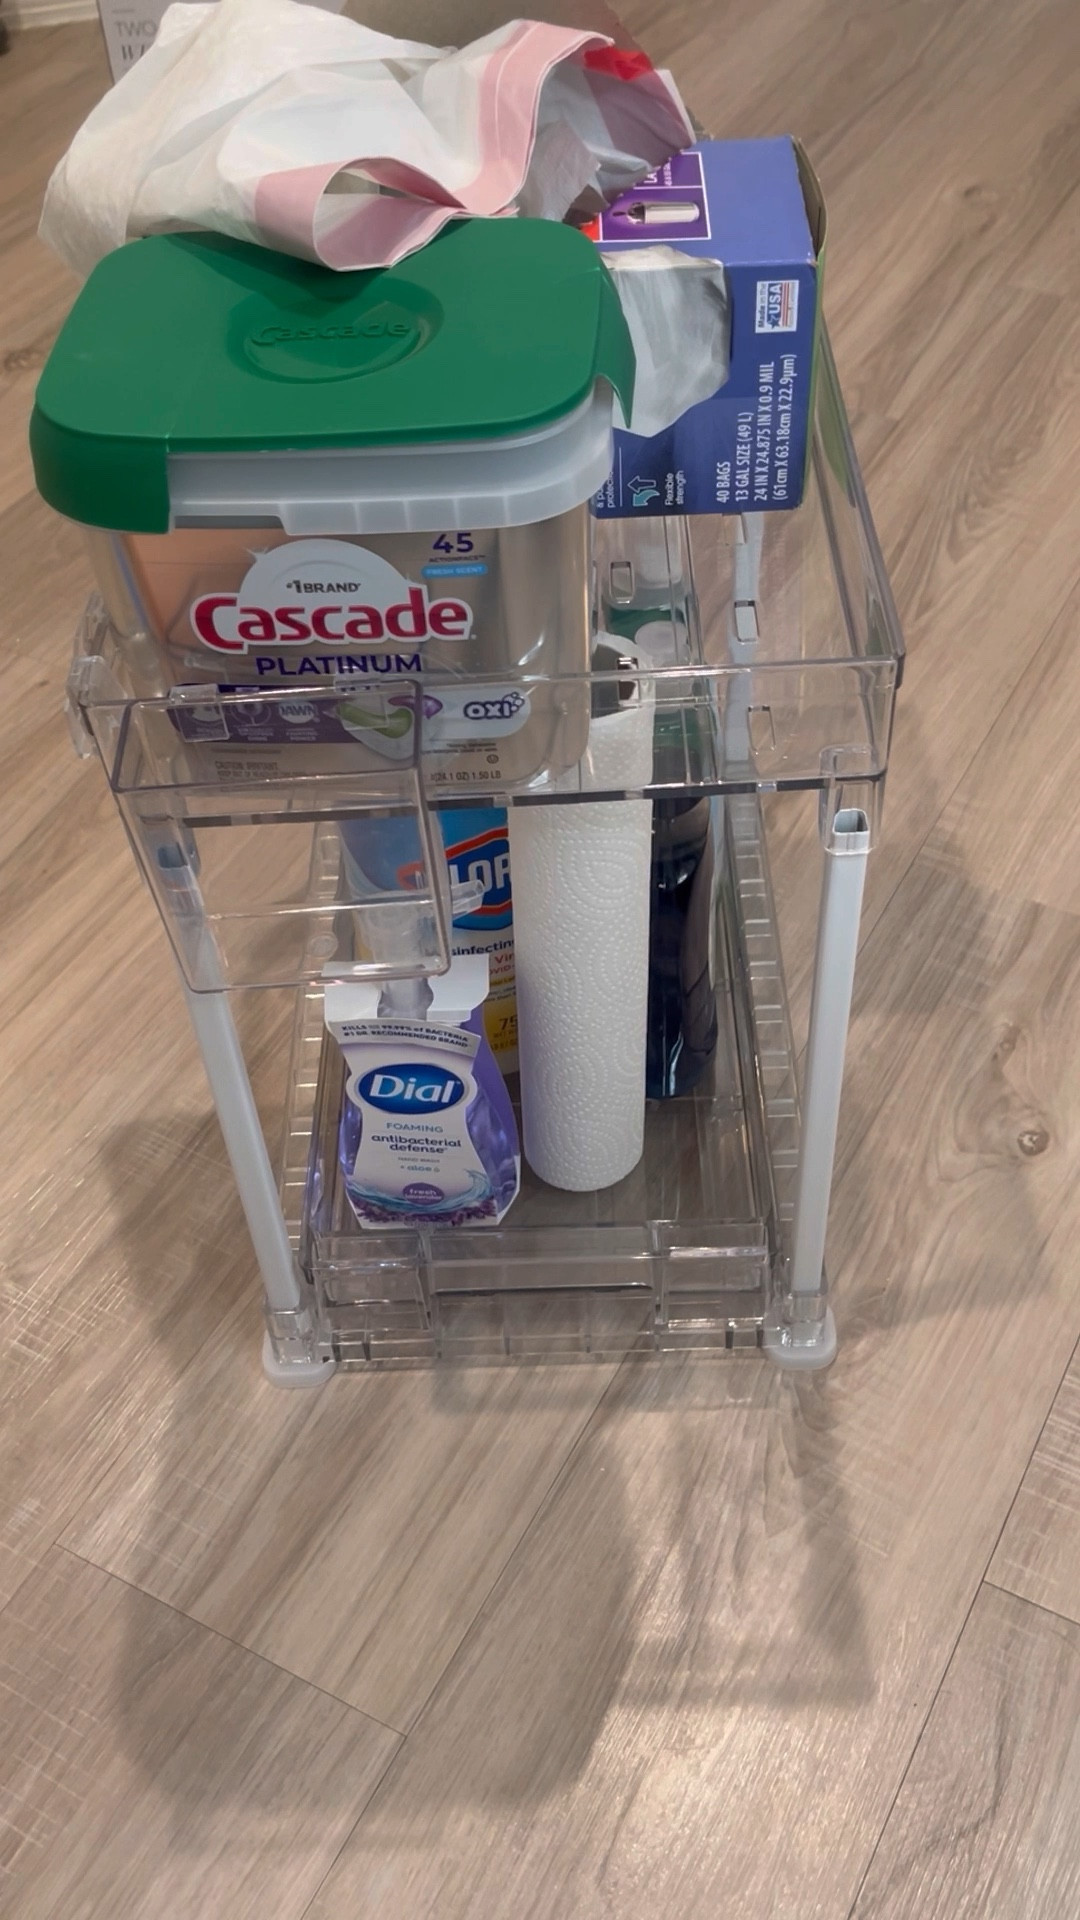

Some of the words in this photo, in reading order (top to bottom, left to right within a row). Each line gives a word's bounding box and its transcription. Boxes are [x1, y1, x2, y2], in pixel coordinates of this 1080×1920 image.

[769, 284, 781, 314] USA
[251, 320, 411, 347] Cascade
[759, 361, 775, 383] MIL
[759, 385, 773, 403] 0.9
[758, 404, 772, 412] X
[778, 403, 792, 411] X
[738, 412, 754, 423] L)
[757, 414, 771, 426] IN
[737, 424, 753, 442] (49
[775, 413, 791, 458] 63.18cm
[737, 443, 750, 466] SIZE
[756, 429, 771, 464] 24.875
[755, 465, 769, 473] X
[774, 459, 788, 467] X
[717, 461, 730, 488] BAGS
[736, 467, 749, 487] GAL
[754, 474, 768, 487] IN
[664, 472, 674, 506] Flexible
[675, 470, 686, 505] strength
[772, 468, 788, 500] (61cm
[717, 490, 730, 503] 40
[736, 489, 749, 501] 13
[754, 489, 767, 501] 24
[432, 532, 474, 553] 45
[195, 587, 469, 650] Cascade
[256, 653, 422, 676] PLATINUM
[448, 852, 511, 893] LOR
[452, 939, 514, 956] sinfectin
[371, 1031, 437, 1041] RECOMMENDED
[438, 1037, 468, 1048] BRAND
[425, 1028, 468, 1042] BACTERIA
[369, 1074, 455, 1103] Dial
[386, 1122, 444, 1133] FOAMING
[371, 1134, 461, 1147] antibacterial
[389, 1142, 444, 1153] defense
